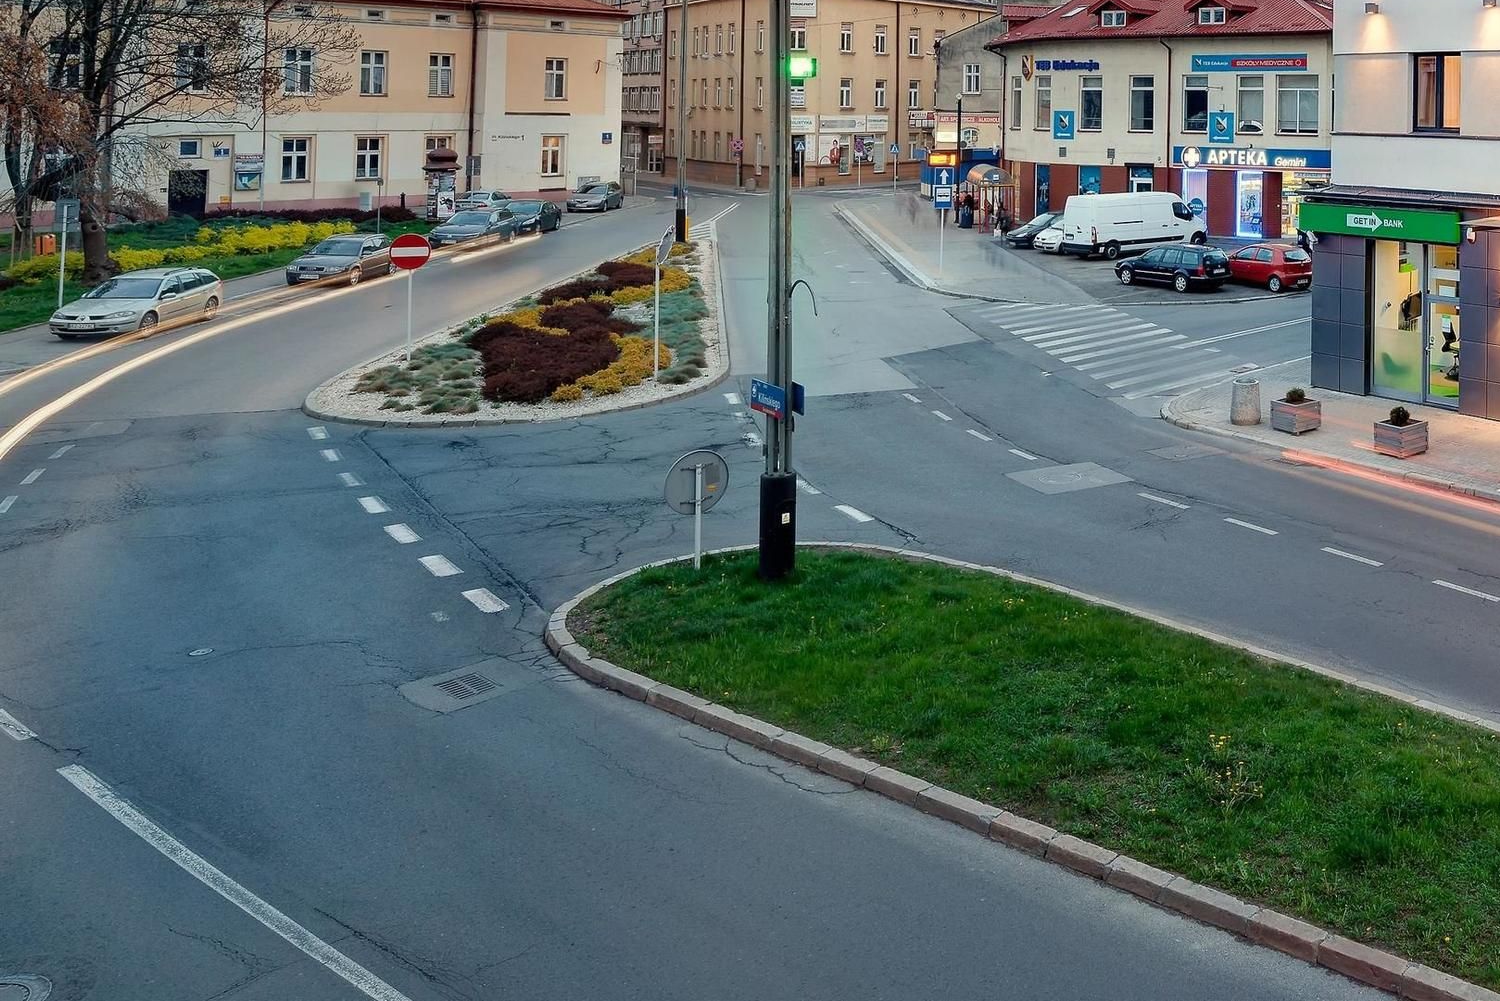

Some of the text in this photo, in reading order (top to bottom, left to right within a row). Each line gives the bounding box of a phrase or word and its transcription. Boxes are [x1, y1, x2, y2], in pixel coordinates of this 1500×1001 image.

[1207, 149, 1307, 167] APTEKA Gemini
[1383, 218, 1404, 228] BANK
